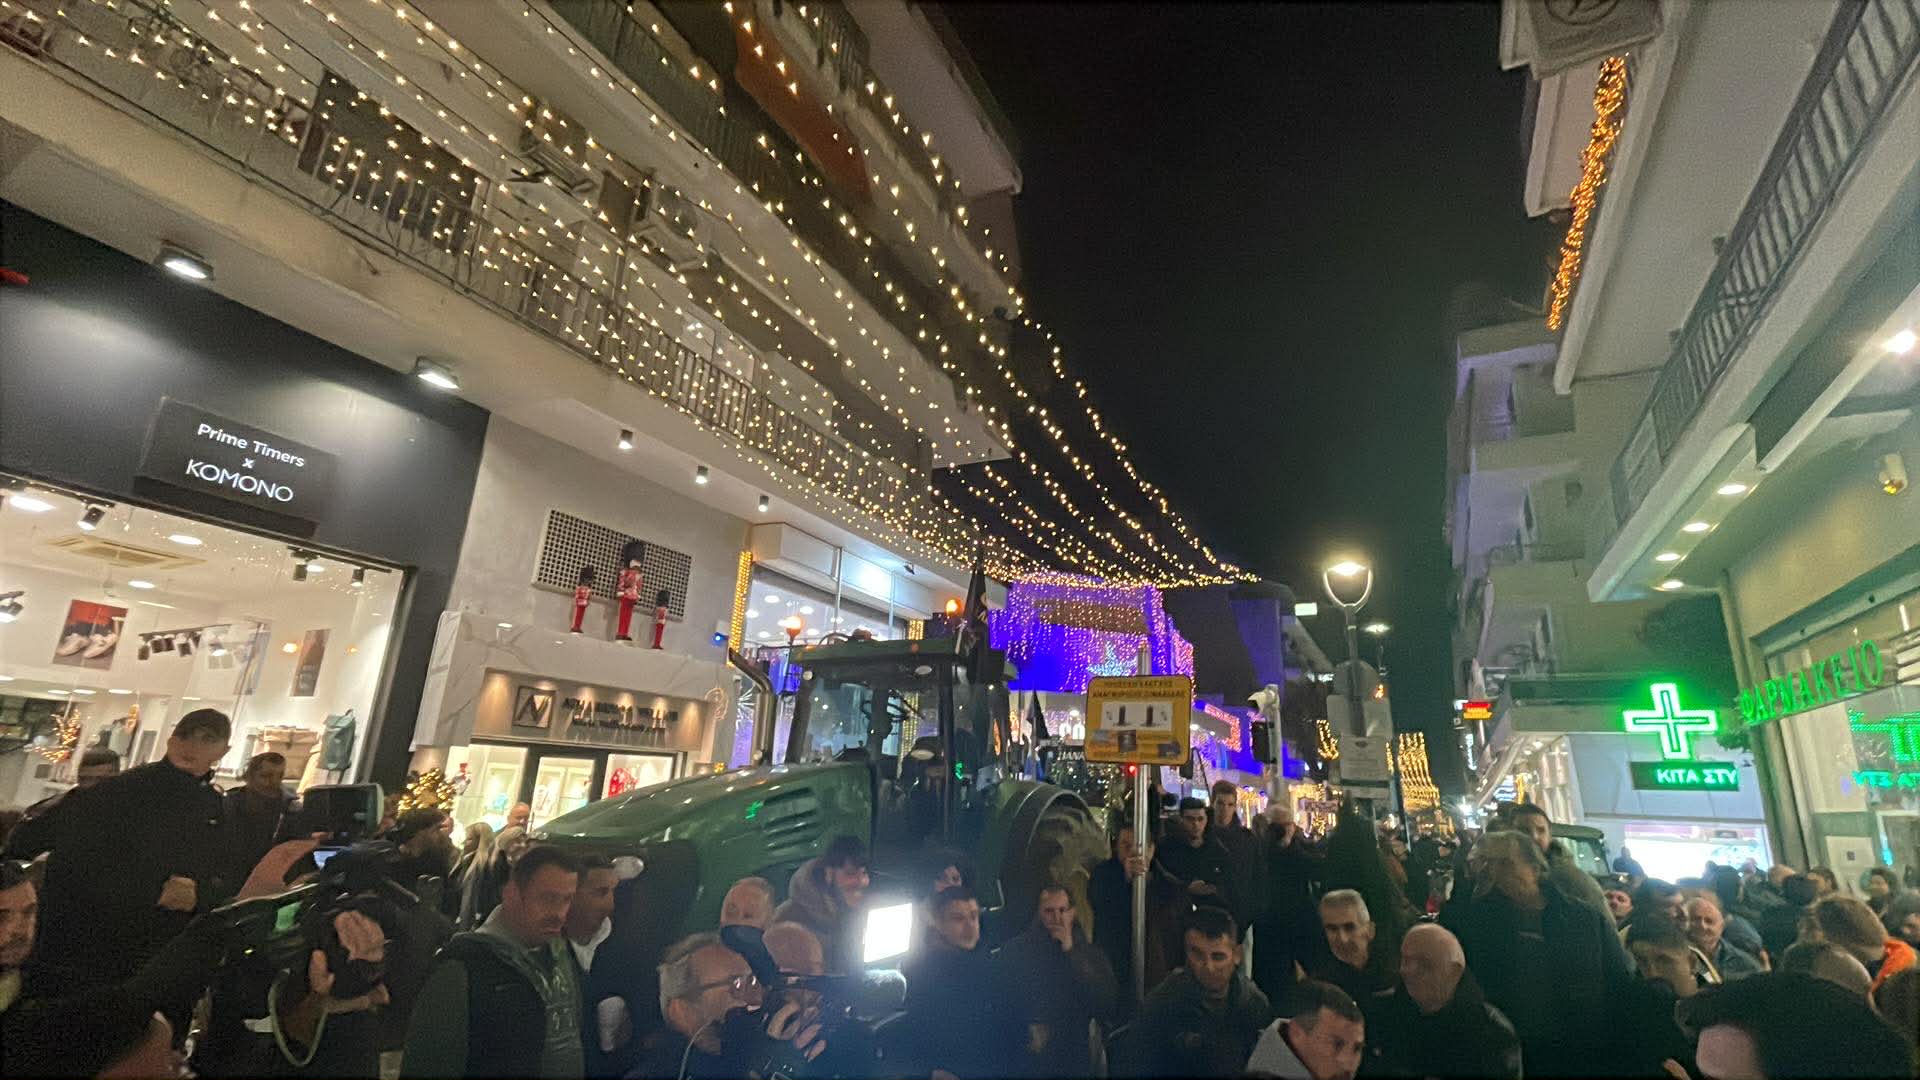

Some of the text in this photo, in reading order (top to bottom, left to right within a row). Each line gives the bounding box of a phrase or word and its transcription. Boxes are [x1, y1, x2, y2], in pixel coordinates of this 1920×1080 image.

[197, 423, 305, 467] Prime Timers
[185, 459, 294, 502] KOMONO
[1740, 639, 1884, 723] ΦΑΡΜΑΚΕΙΟ
[1656, 768, 1737, 785] ΚΙΤΑ ΣΤΥ
